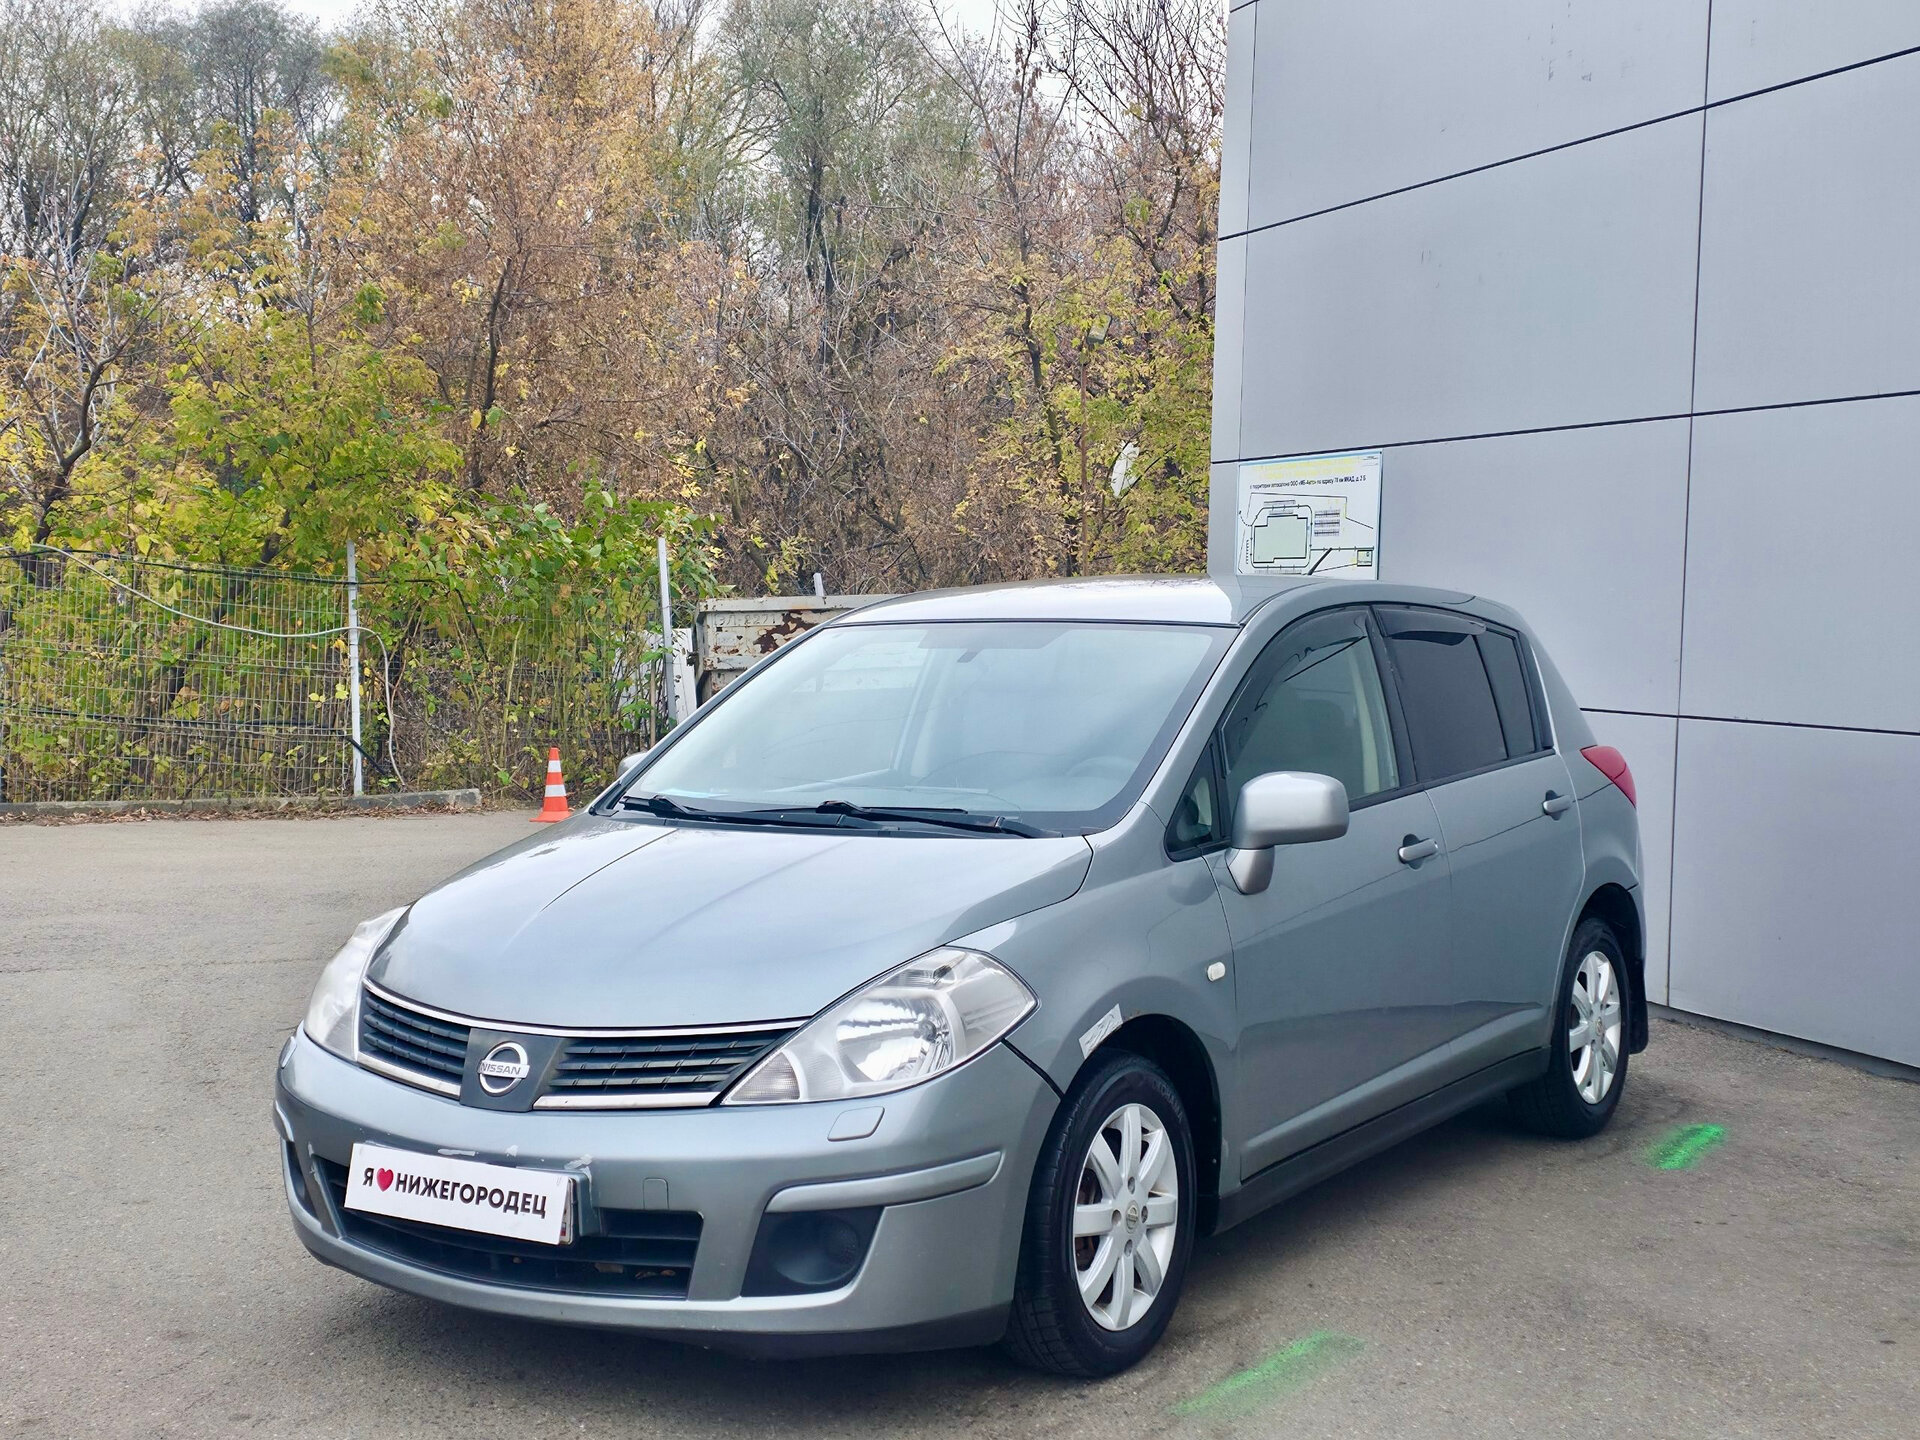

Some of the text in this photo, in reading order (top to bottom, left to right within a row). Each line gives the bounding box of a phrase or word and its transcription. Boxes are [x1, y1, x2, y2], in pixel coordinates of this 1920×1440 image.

[480, 1062, 521, 1075] NISSAN
[362, 1167, 546, 1218] Я НИЖЕГОРОДЕЦ
